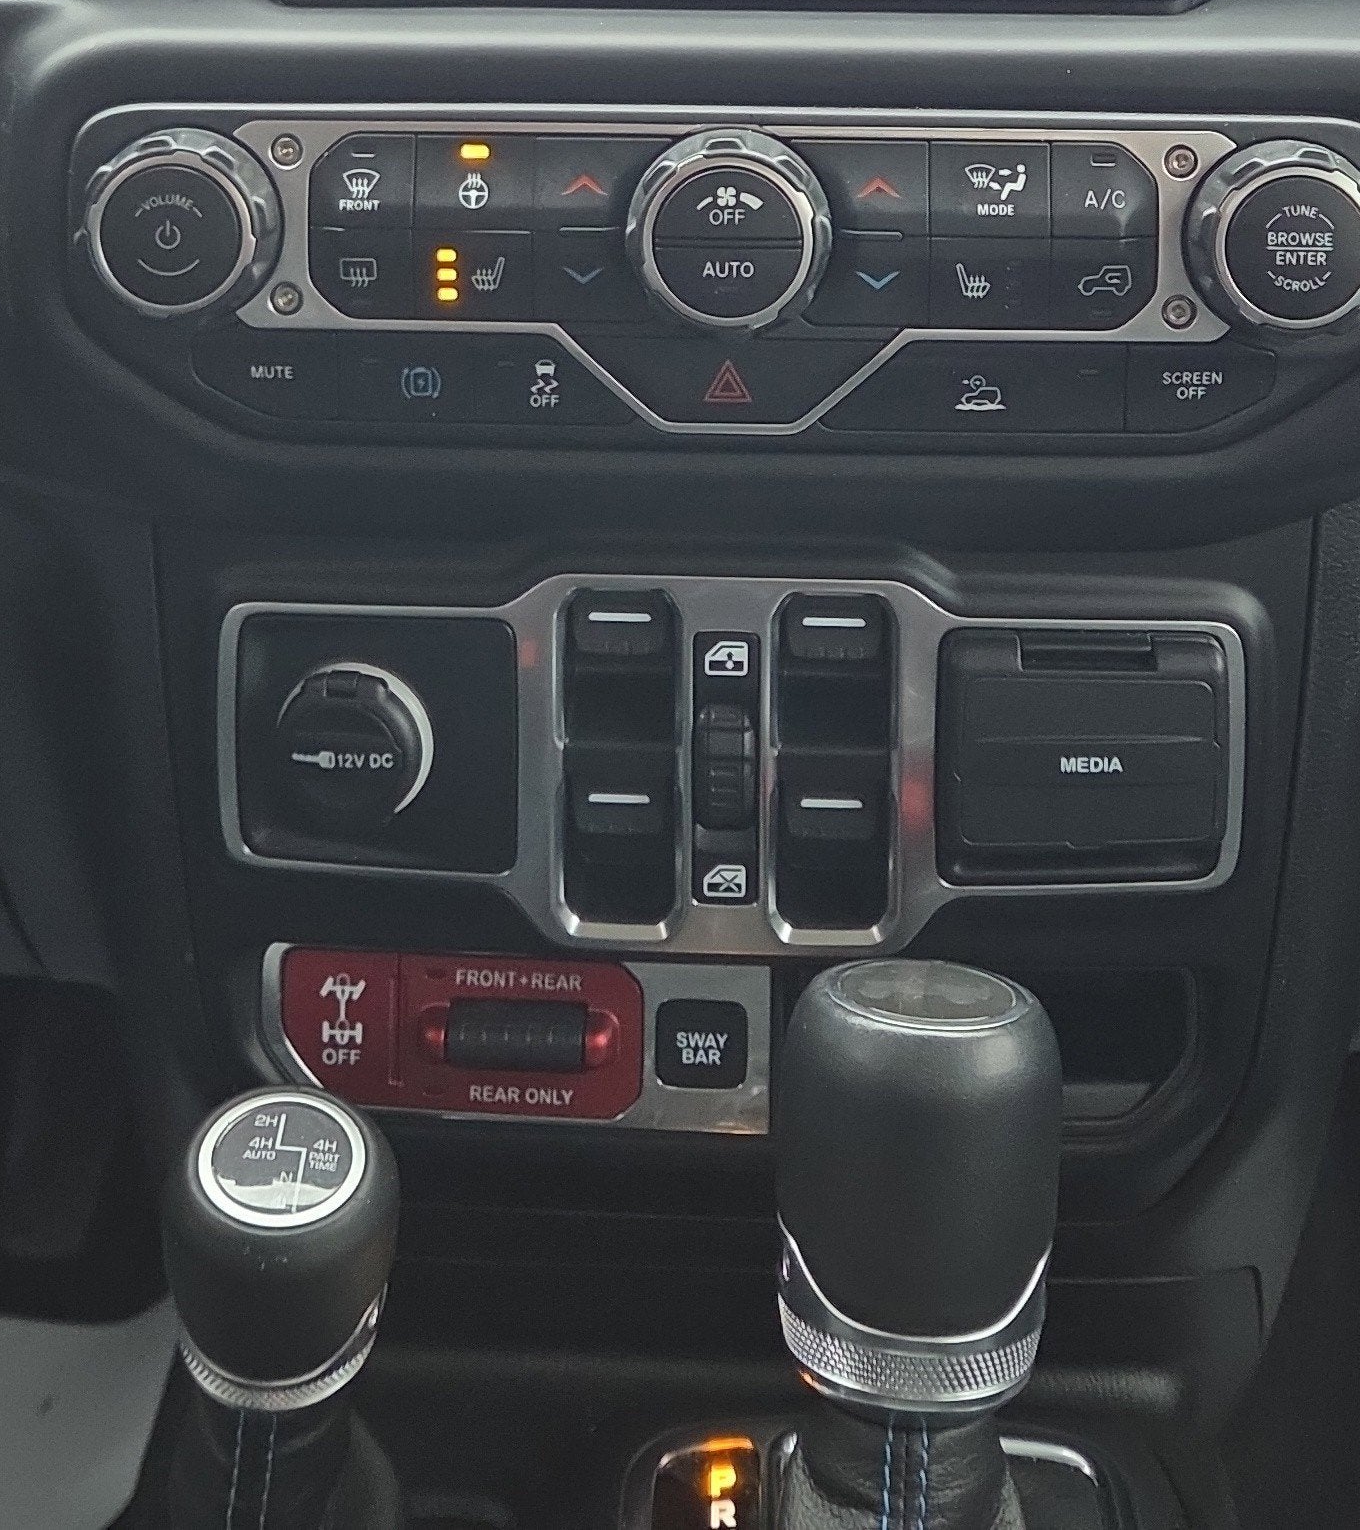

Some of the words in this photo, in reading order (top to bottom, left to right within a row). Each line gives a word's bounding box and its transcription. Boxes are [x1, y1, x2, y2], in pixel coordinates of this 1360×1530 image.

[141, 194, 194, 210] VOLUME
[339, 199, 381, 211] FRONT
[1084, 189, 1127, 210] A/C
[709, 208, 746, 226] OFF
[977, 203, 1015, 216] MODE
[1282, 204, 1319, 219] TUNE
[1267, 231, 1334, 246] BROWSE
[1275, 251, 1327, 265] ENTER
[702, 261, 755, 278] AUTO
[1273, 275, 1327, 292] SCROLL
[250, 365, 294, 380] MUTE
[1162, 371, 1223, 386] SCREEN
[1177, 386, 1207, 400] OFF
[529, 395, 560, 408] OFF
[337, 753, 366, 769] 12V
[369, 753, 394, 769] DC
[1060, 756, 1124, 773] MEDIA
[676, 1031, 728, 1049] SWAY
[322, 1048, 362, 1066] OFF
[681, 1048, 722, 1066] BAR
[469, 1084, 520, 1104] REAR
[525, 1087, 574, 1106] ONLY
[254, 1114, 278, 1127] 2H
[248, 1136, 273, 1149] 4H
[313, 1139, 337, 1152] 4H
[242, 1150, 276, 1161] AUTO
[309, 1151, 340, 1163] PART
[309, 1161, 337, 1172] TIME
[710, 1464, 737, 1498] P
[710, 1499, 737, 1529] R
